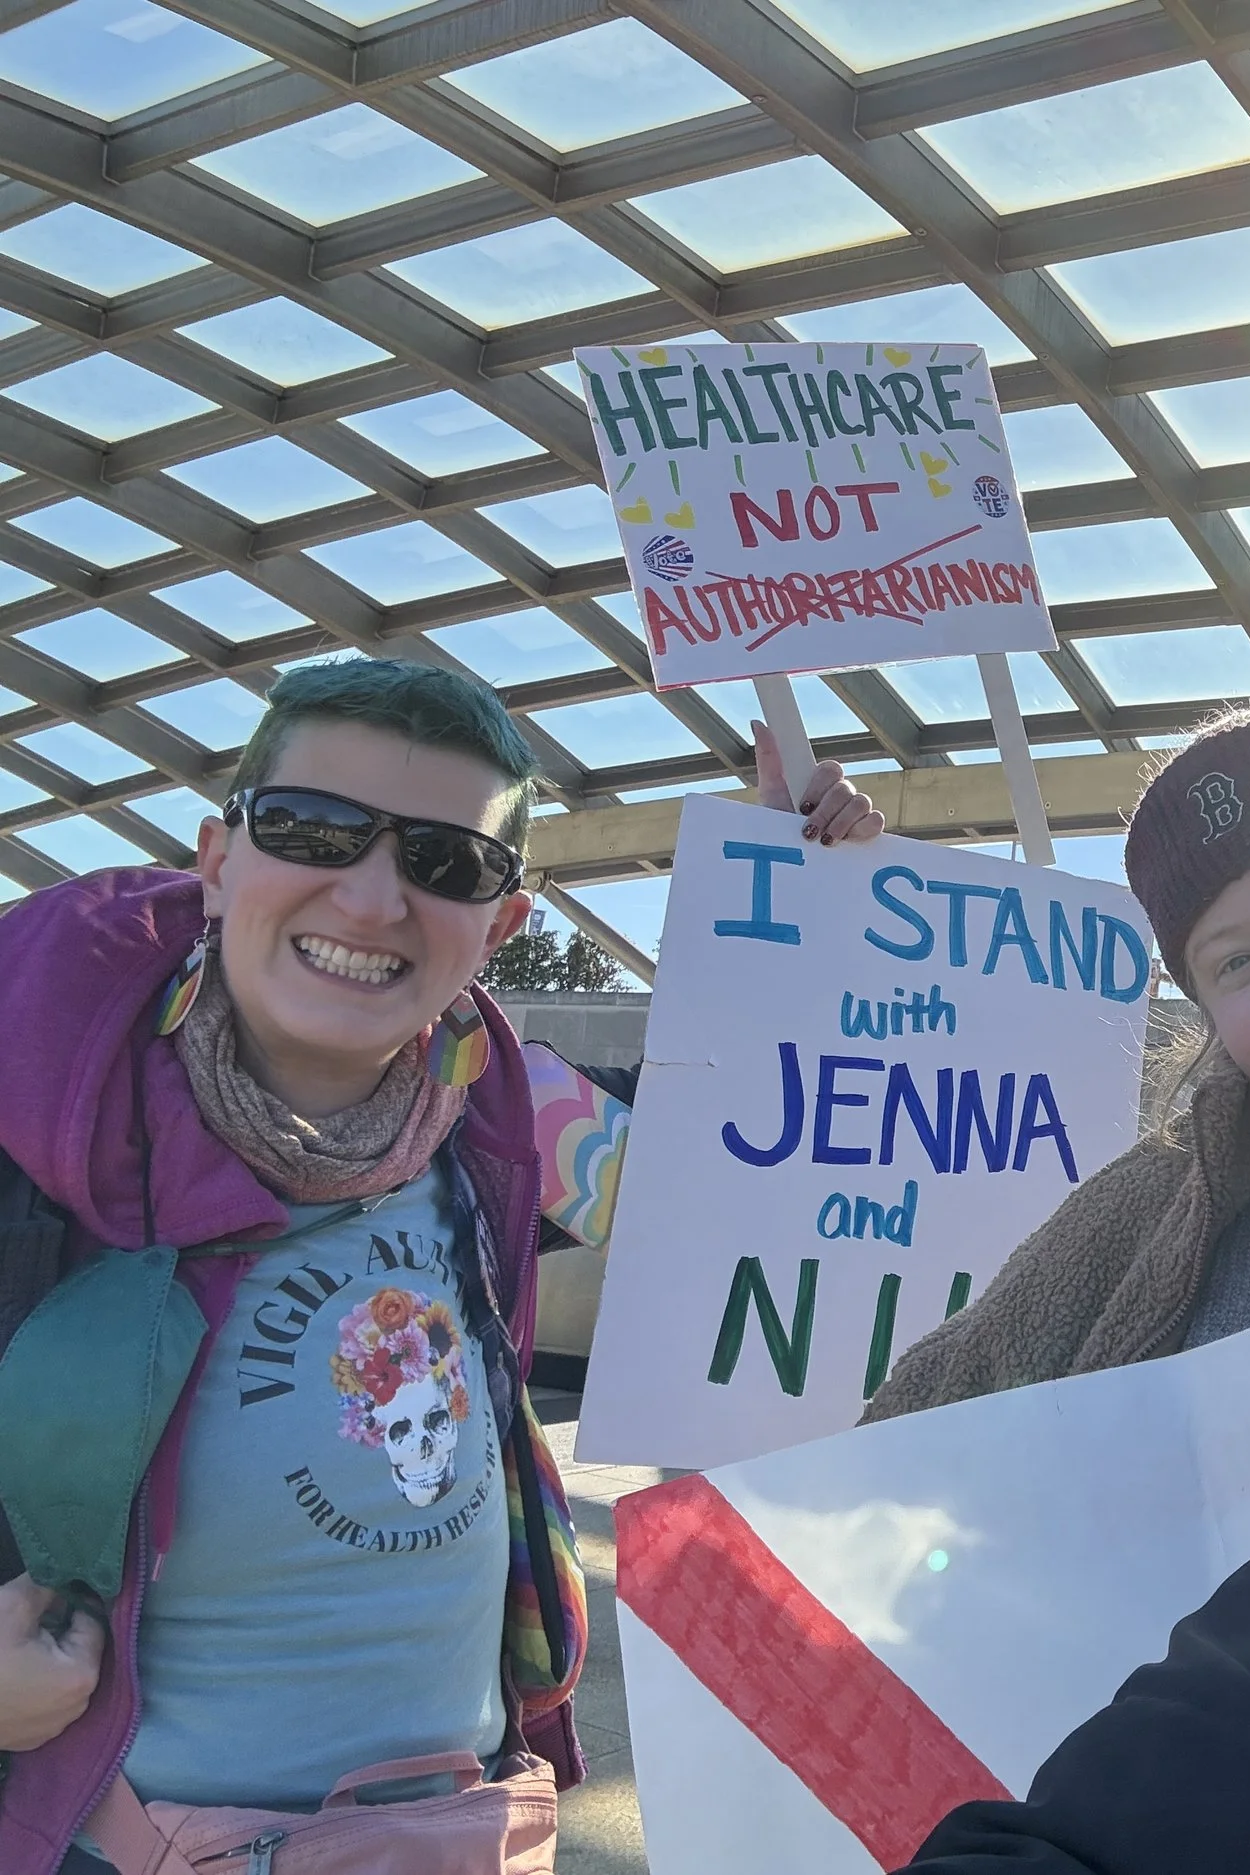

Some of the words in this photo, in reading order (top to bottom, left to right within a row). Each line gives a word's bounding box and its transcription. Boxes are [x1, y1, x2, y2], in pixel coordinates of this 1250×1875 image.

[590, 361, 976, 457] HEALTHCARE
[729, 482, 900, 548] NOT
[642, 559, 1041, 656] AUTHORITARIANISM
[1186, 772, 1244, 845] B
[714, 840, 806, 945] I
[864, 865, 1151, 1004] STAND
[840, 984, 957, 1041] with
[721, 1041, 1080, 1183] JENNA
[816, 1180, 918, 1247] and
[237, 1262, 354, 1409] VIGIL
[284, 1465, 336, 1528] FOR
[325, 1514, 443, 1553] HEALTH
